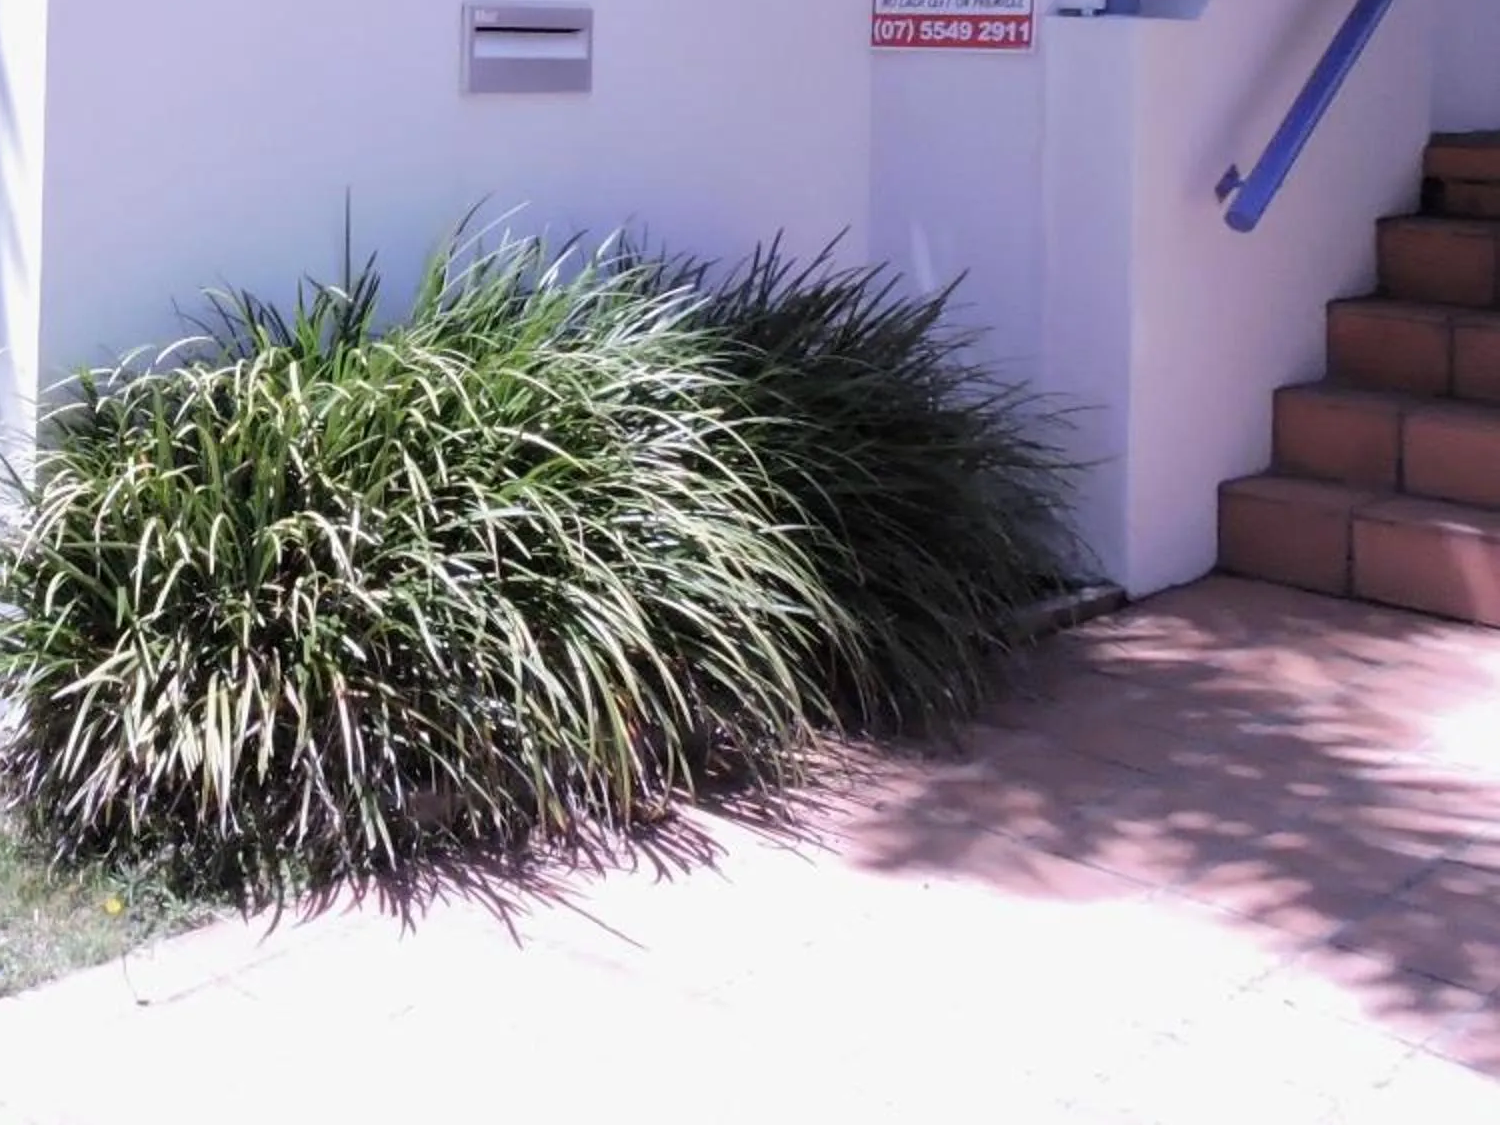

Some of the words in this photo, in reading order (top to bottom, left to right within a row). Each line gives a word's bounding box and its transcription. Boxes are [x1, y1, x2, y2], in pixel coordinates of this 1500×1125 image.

[874, 19, 914, 43] (07)
[919, 21, 973, 41] 5549
[977, 21, 1030, 42] 2911
